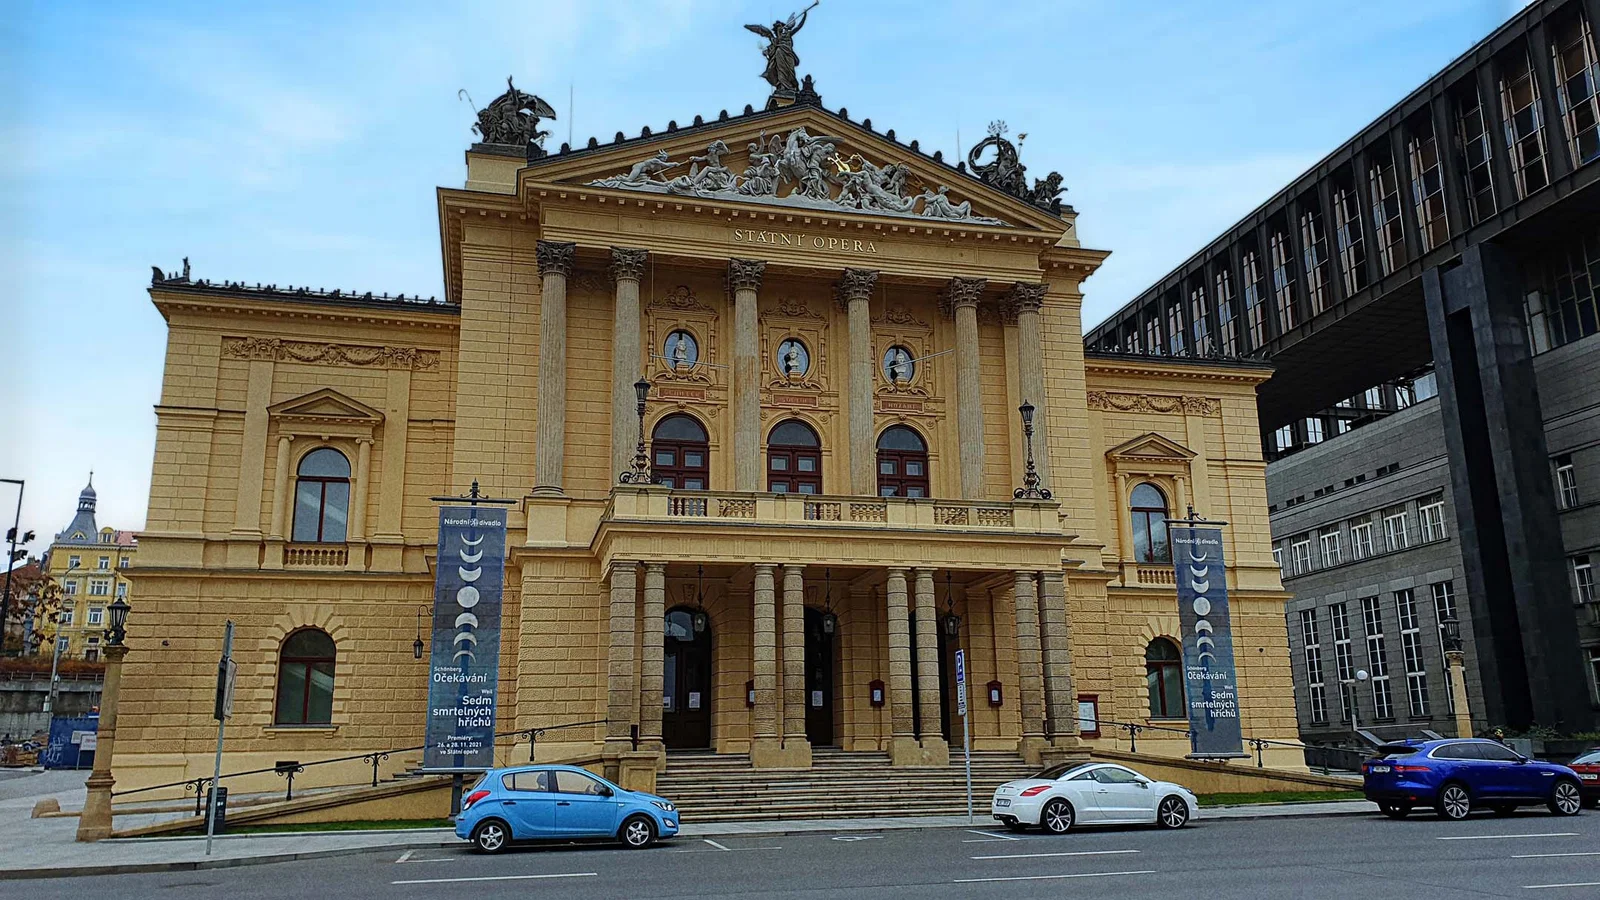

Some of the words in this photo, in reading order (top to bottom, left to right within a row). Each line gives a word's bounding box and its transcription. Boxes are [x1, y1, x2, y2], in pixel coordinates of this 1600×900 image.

[734, 228, 805, 246] STÁTNÍ
[813, 236, 877, 253] OPERA
[433, 673, 488, 683] Očekávání
[1187, 671, 1227, 680] Očekávání
[1211, 690, 1234, 699] Sedm
[462, 696, 492, 705] Sedm
[1191, 700, 1235, 710] smrtelných
[433, 706, 492, 718] smrtelných
[1210, 709, 1236, 718] hříchů
[458, 717, 491, 727] hříchů
